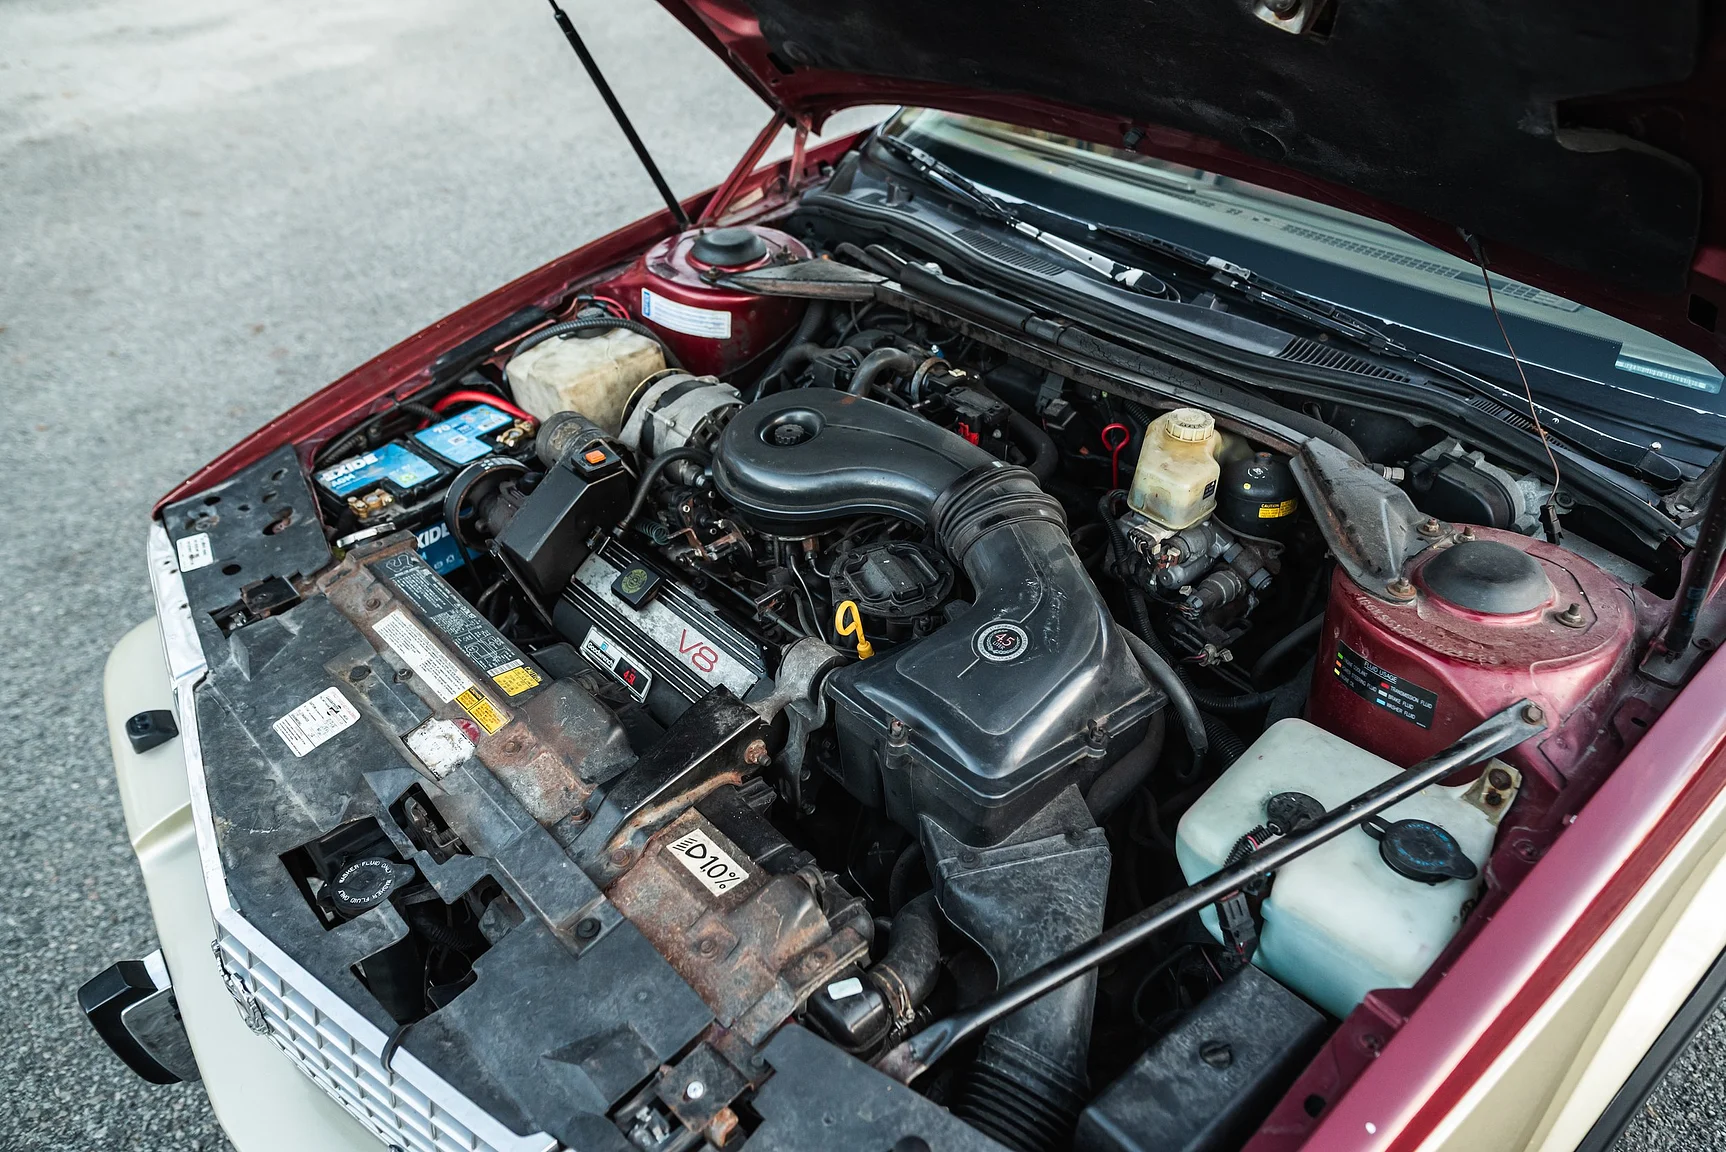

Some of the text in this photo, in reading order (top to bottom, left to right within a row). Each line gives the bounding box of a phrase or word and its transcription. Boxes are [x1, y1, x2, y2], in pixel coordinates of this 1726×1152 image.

[322, 452, 379, 481] EXIDE
[679, 628, 719, 673] V8
[995, 633, 1015, 647] 4.5
[587, 640, 615, 668] Goodwrench
[1353, 665, 1368, 677] COOLANT
[1364, 661, 1398, 682] FLUID USAGE
[1351, 672, 1366, 687] STEERING
[1366, 683, 1378, 693] FLUID
[1387, 694, 1414, 710] BRAKE FLUID
[1390, 686, 1433, 710] TRANSMISSION FLUID
[1386, 703, 1416, 720] WASHER FLUID
[338, 864, 360, 884] WASHER
[381, 863, 393, 876] ONLY
[338, 879, 392, 904] WASHER FLUID ONLY
